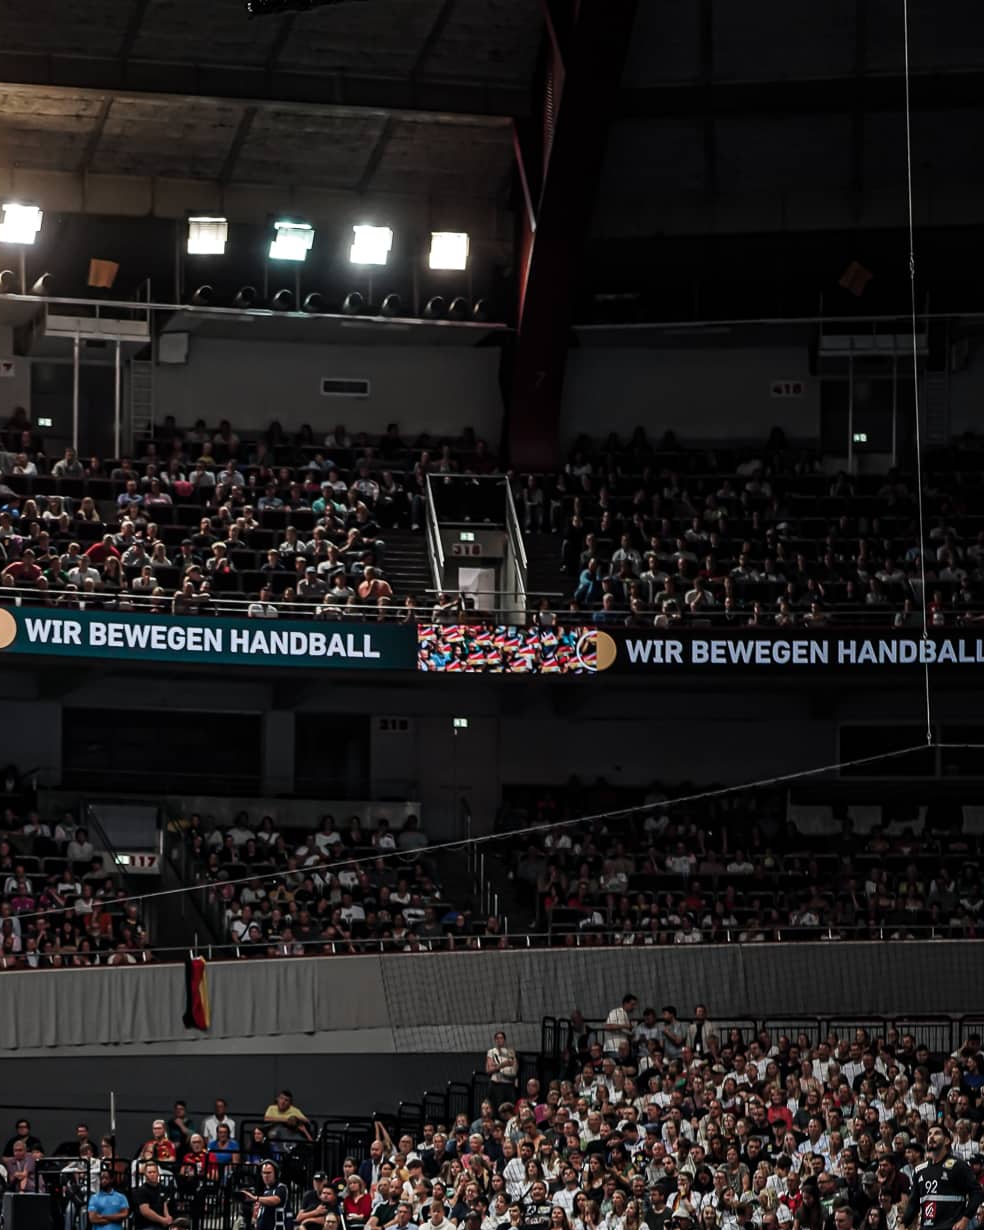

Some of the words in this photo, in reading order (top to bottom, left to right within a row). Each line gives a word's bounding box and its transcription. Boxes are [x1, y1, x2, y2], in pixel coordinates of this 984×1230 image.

[24, 618, 82, 645] WIR
[89, 622, 223, 652] BEWEGEN
[231, 629, 381, 659] HANDBALL
[625, 639, 684, 664] WIR
[691, 639, 828, 664] BEWEGEN
[925, 1180, 938, 1194] 92
